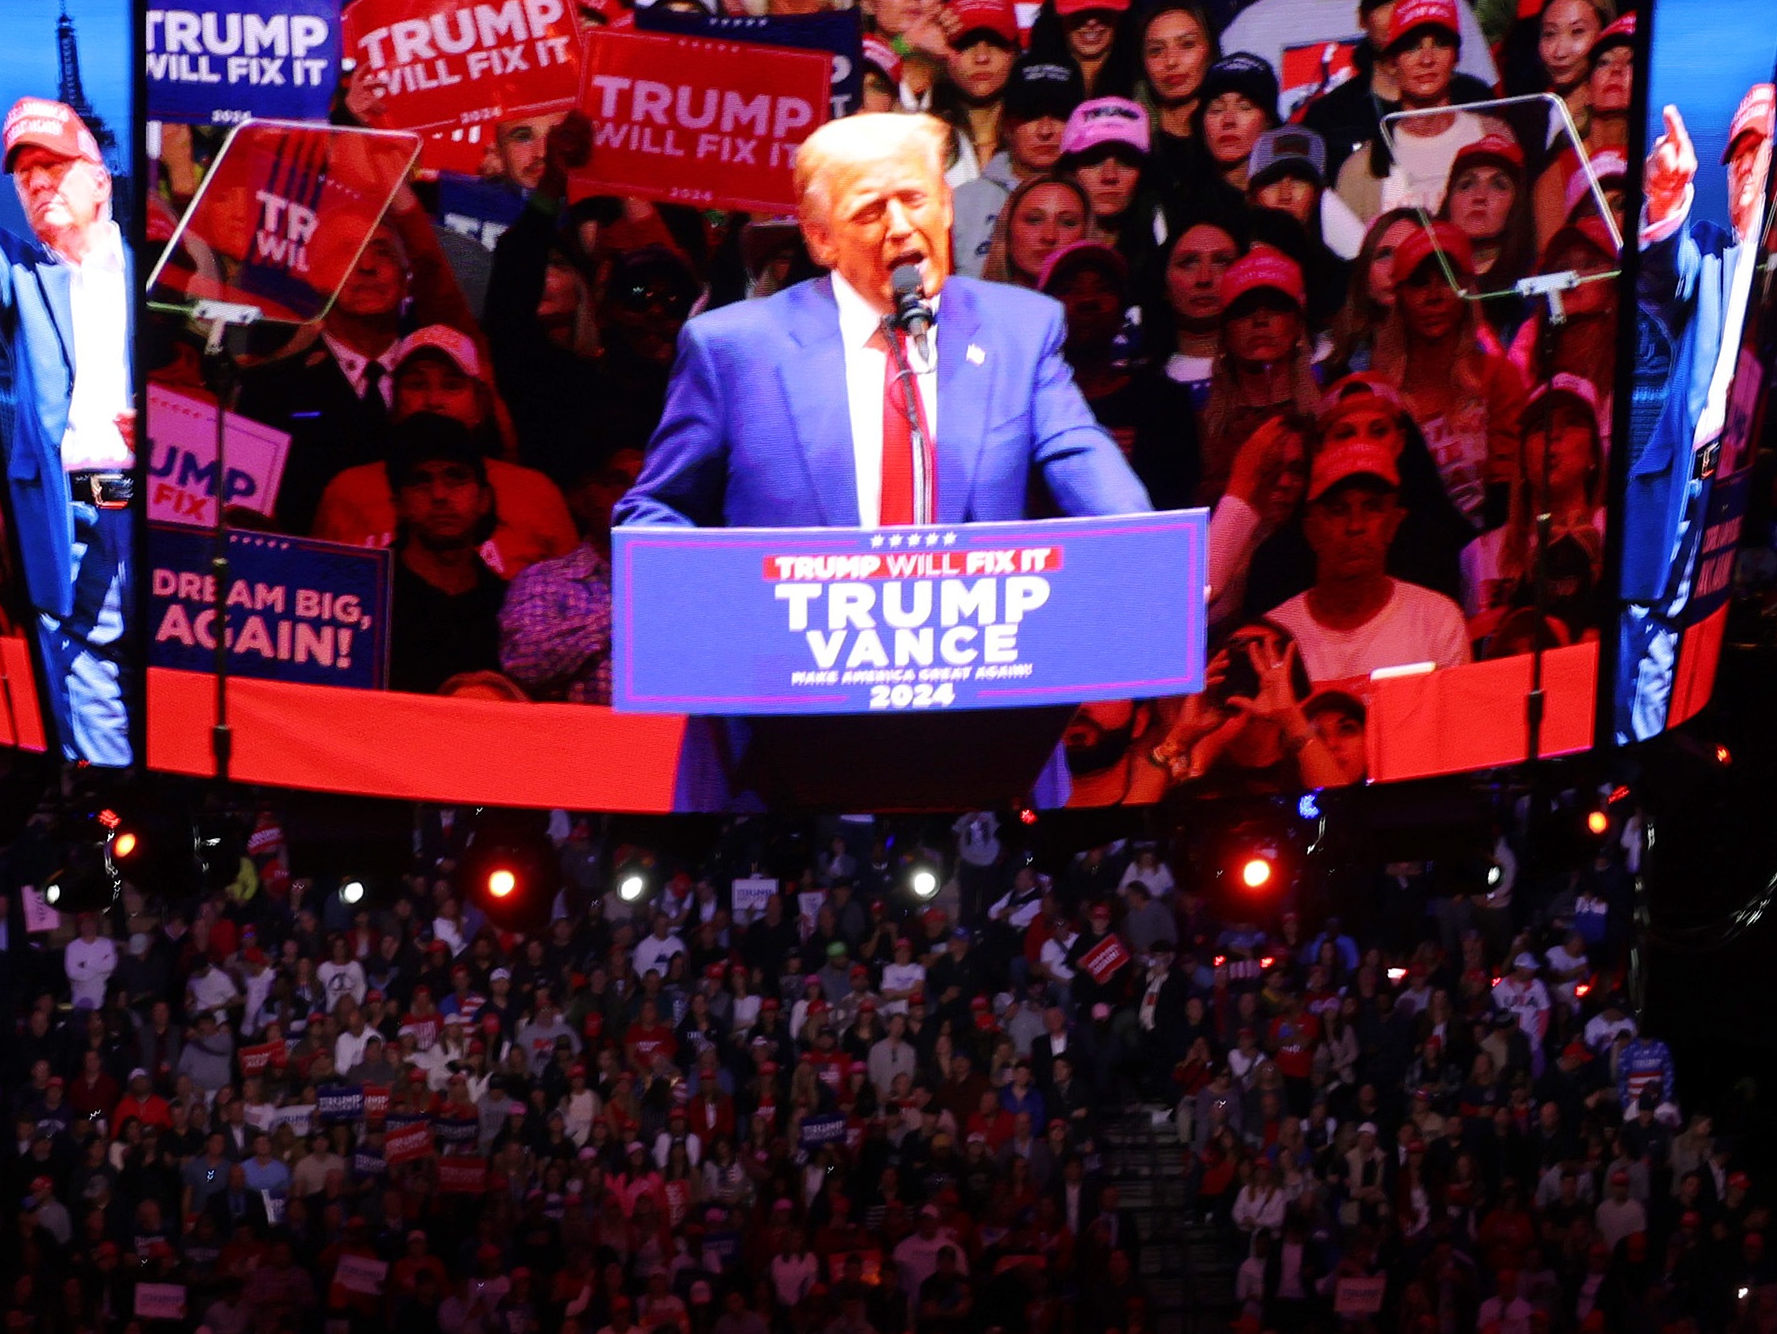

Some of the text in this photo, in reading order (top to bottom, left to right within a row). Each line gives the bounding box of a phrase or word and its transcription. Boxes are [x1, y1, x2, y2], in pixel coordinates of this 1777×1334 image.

[226, 55, 285, 86] FIX
[293, 57, 328, 88] IT
[467, 44, 531, 83] FIX
[540, 34, 571, 67] IT
[591, 74, 814, 138] TRUMP
[594, 120, 685, 156] WILL
[696, 132, 758, 165] FIX
[775, 548, 1051, 580] TRUMP WILL FIX IT
[152, 568, 372, 633] DREAM BIG,
[774, 575, 1051, 632] TRUMP
[156, 603, 354, 669] AGAIN!
[806, 622, 1019, 669] VANCE
[869, 682, 956, 708] 2024
